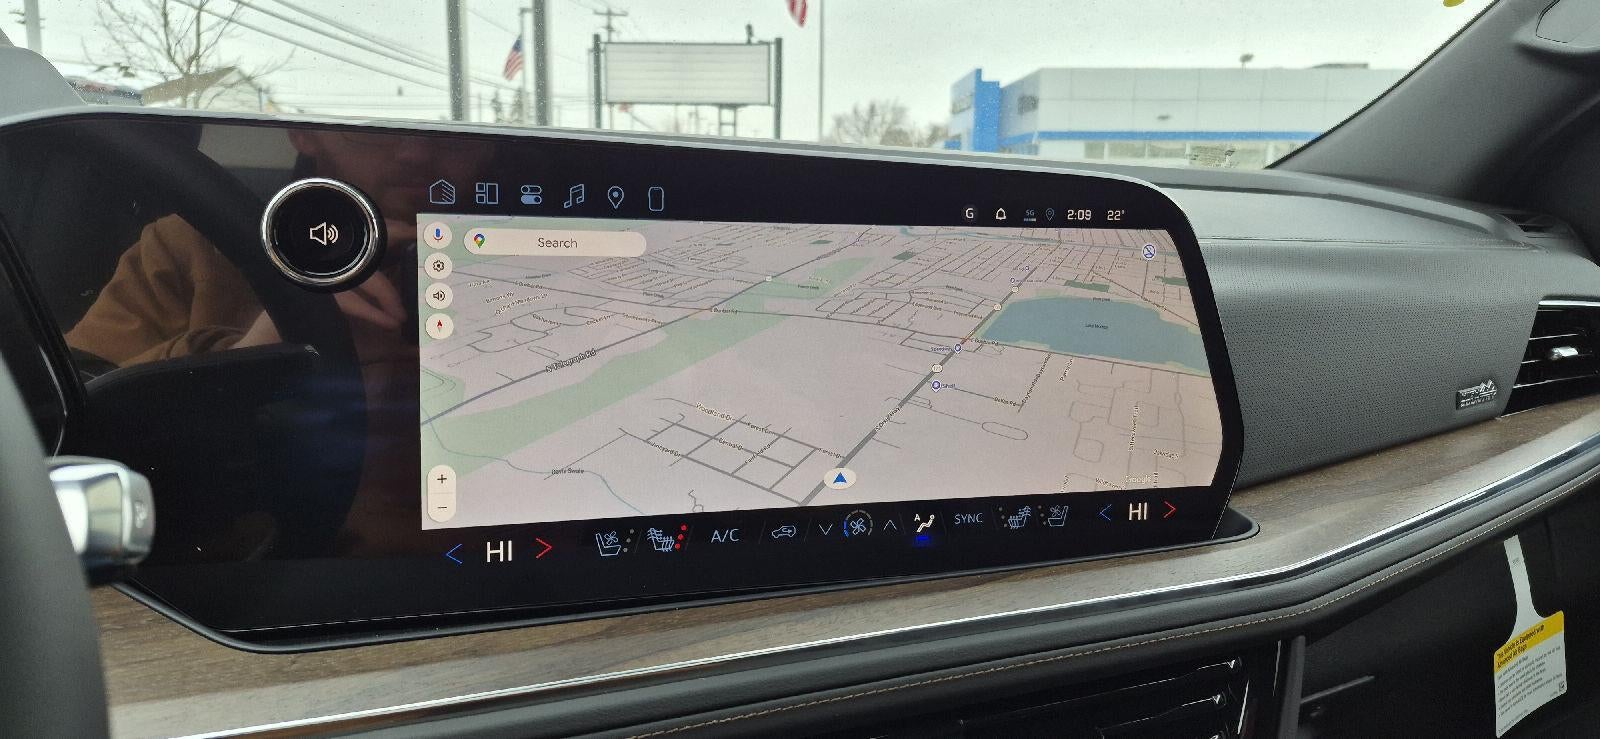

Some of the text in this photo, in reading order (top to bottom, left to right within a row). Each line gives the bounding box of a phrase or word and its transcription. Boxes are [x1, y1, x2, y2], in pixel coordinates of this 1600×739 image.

[965, 208, 974, 219] G
[1067, 209, 1092, 221] 2:09
[537, 237, 578, 250] Search
[585, 347, 597, 359] Rd
[954, 512, 984, 525] SYNC
[1128, 503, 1148, 521] HI
[710, 528, 740, 543] A/C
[486, 540, 513, 563] HI
